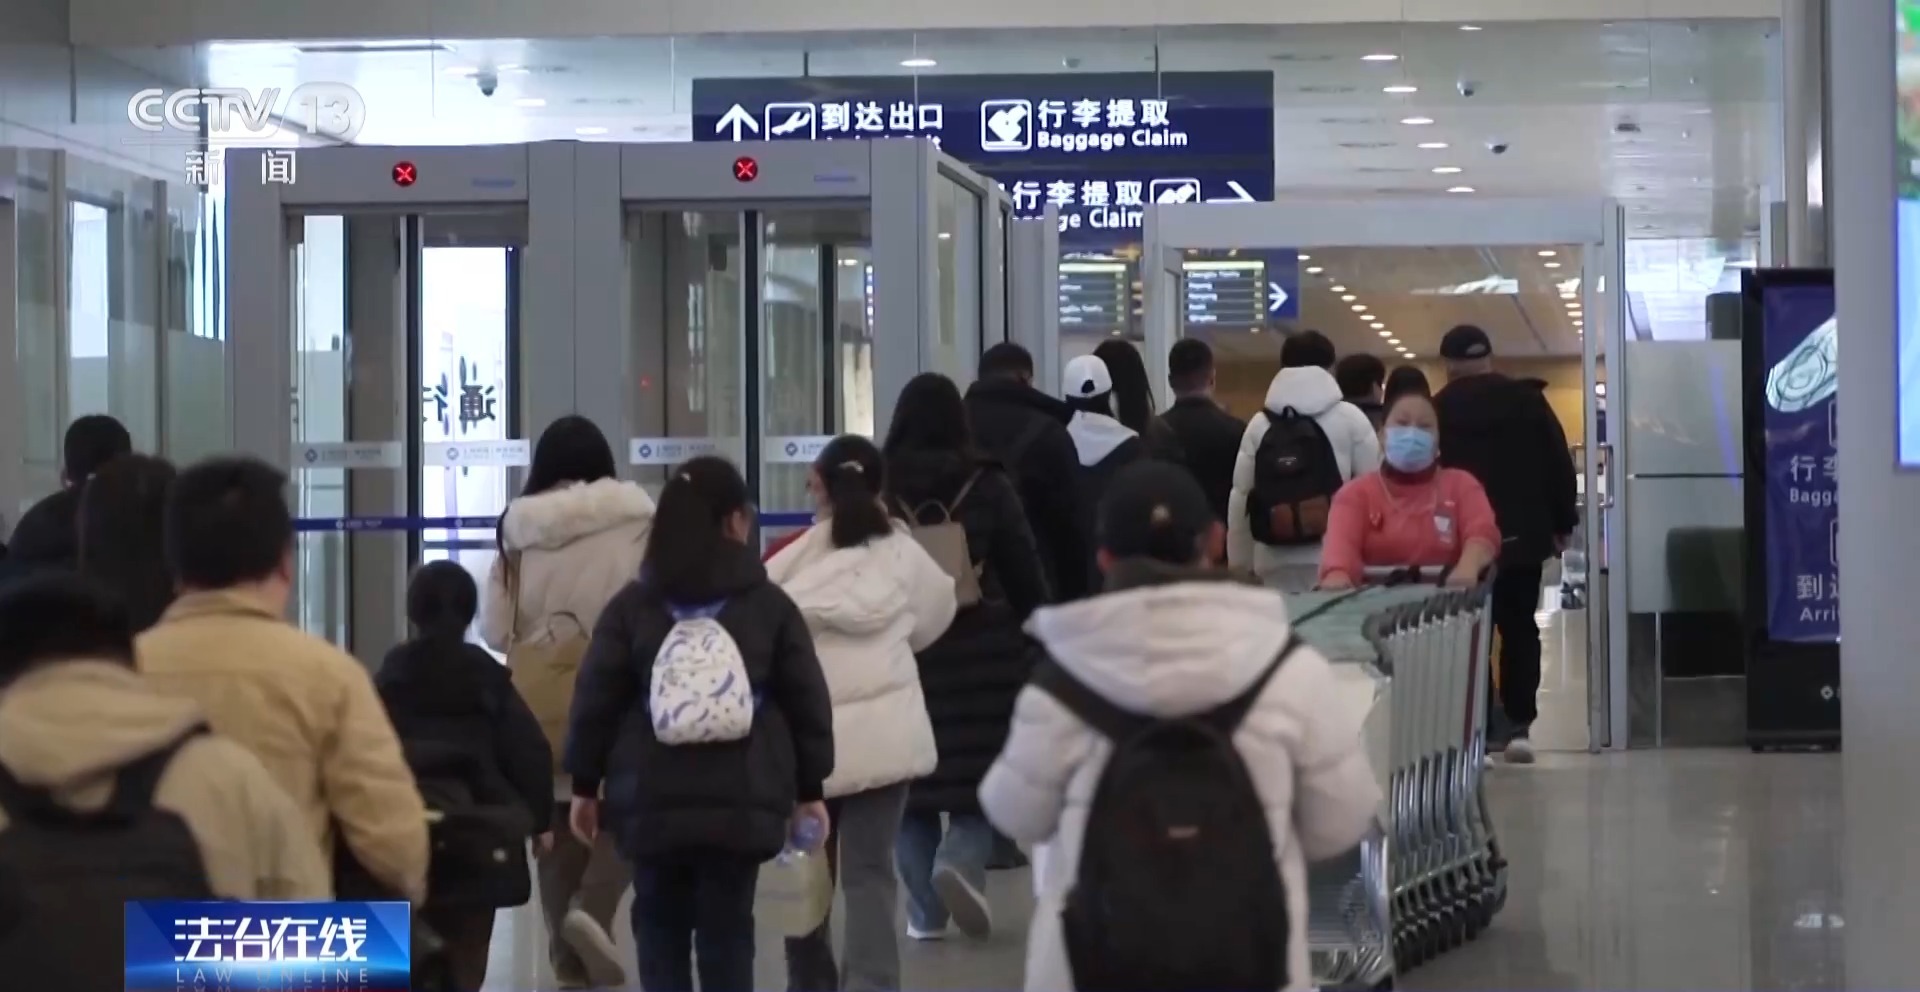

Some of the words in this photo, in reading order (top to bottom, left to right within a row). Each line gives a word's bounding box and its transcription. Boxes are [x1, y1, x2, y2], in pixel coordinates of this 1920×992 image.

[821, 101, 943, 132] 到达出口
[1037, 98, 1171, 129] 行李提取
[1037, 131, 1126, 152] Baggage
[1131, 128, 1188, 146] Claim
[1012, 180, 1144, 210] 行李提取
[1800, 605, 1840, 621] Arri
